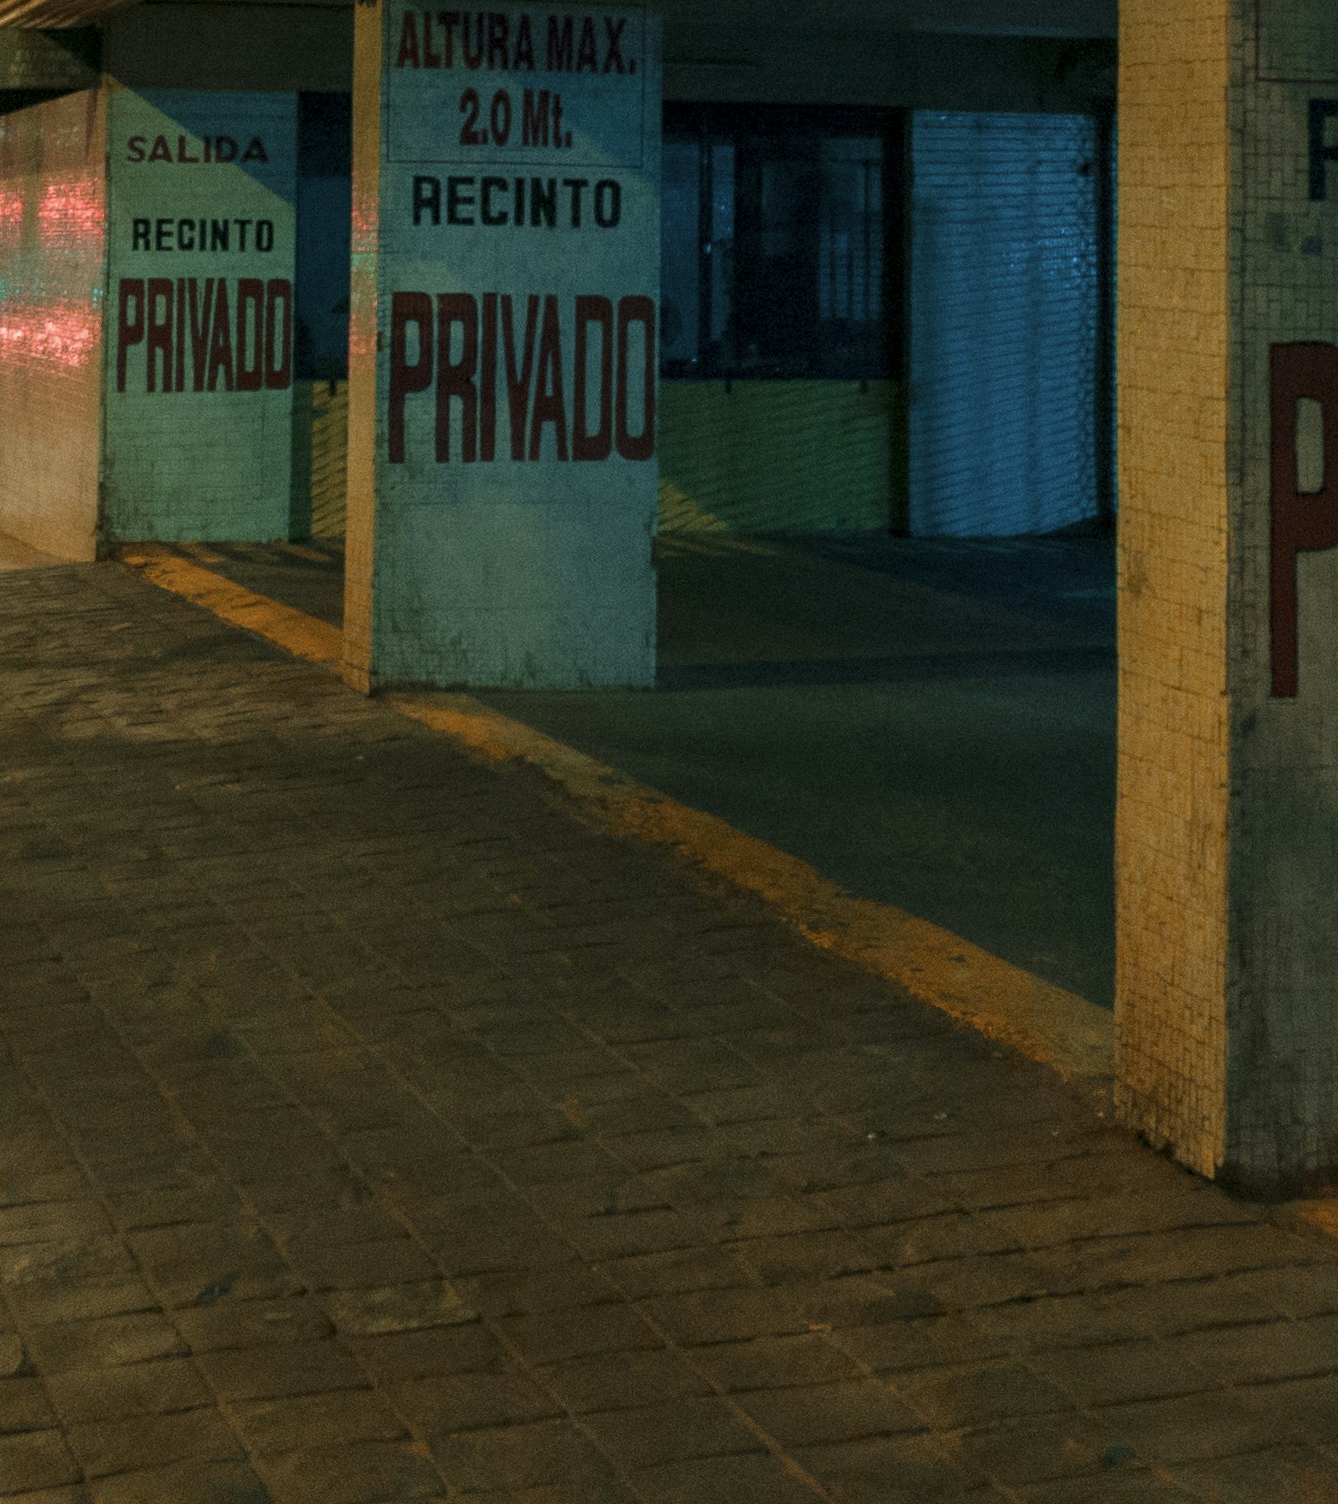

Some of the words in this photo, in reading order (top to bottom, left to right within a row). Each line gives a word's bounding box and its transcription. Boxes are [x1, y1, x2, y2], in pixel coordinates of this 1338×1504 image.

[396, 11, 534, 72] ALTURA
[547, 17, 637, 74] MAX.
[126, 135, 270, 164] SALIDA
[459, 88, 512, 146] 2.0
[521, 89, 574, 150] Mt.
[411, 176, 622, 228] RECINTO
[131, 218, 274, 253] RECINTO
[117, 278, 293, 393] PRIVADO
[387, 292, 656, 464] PRIVADO
